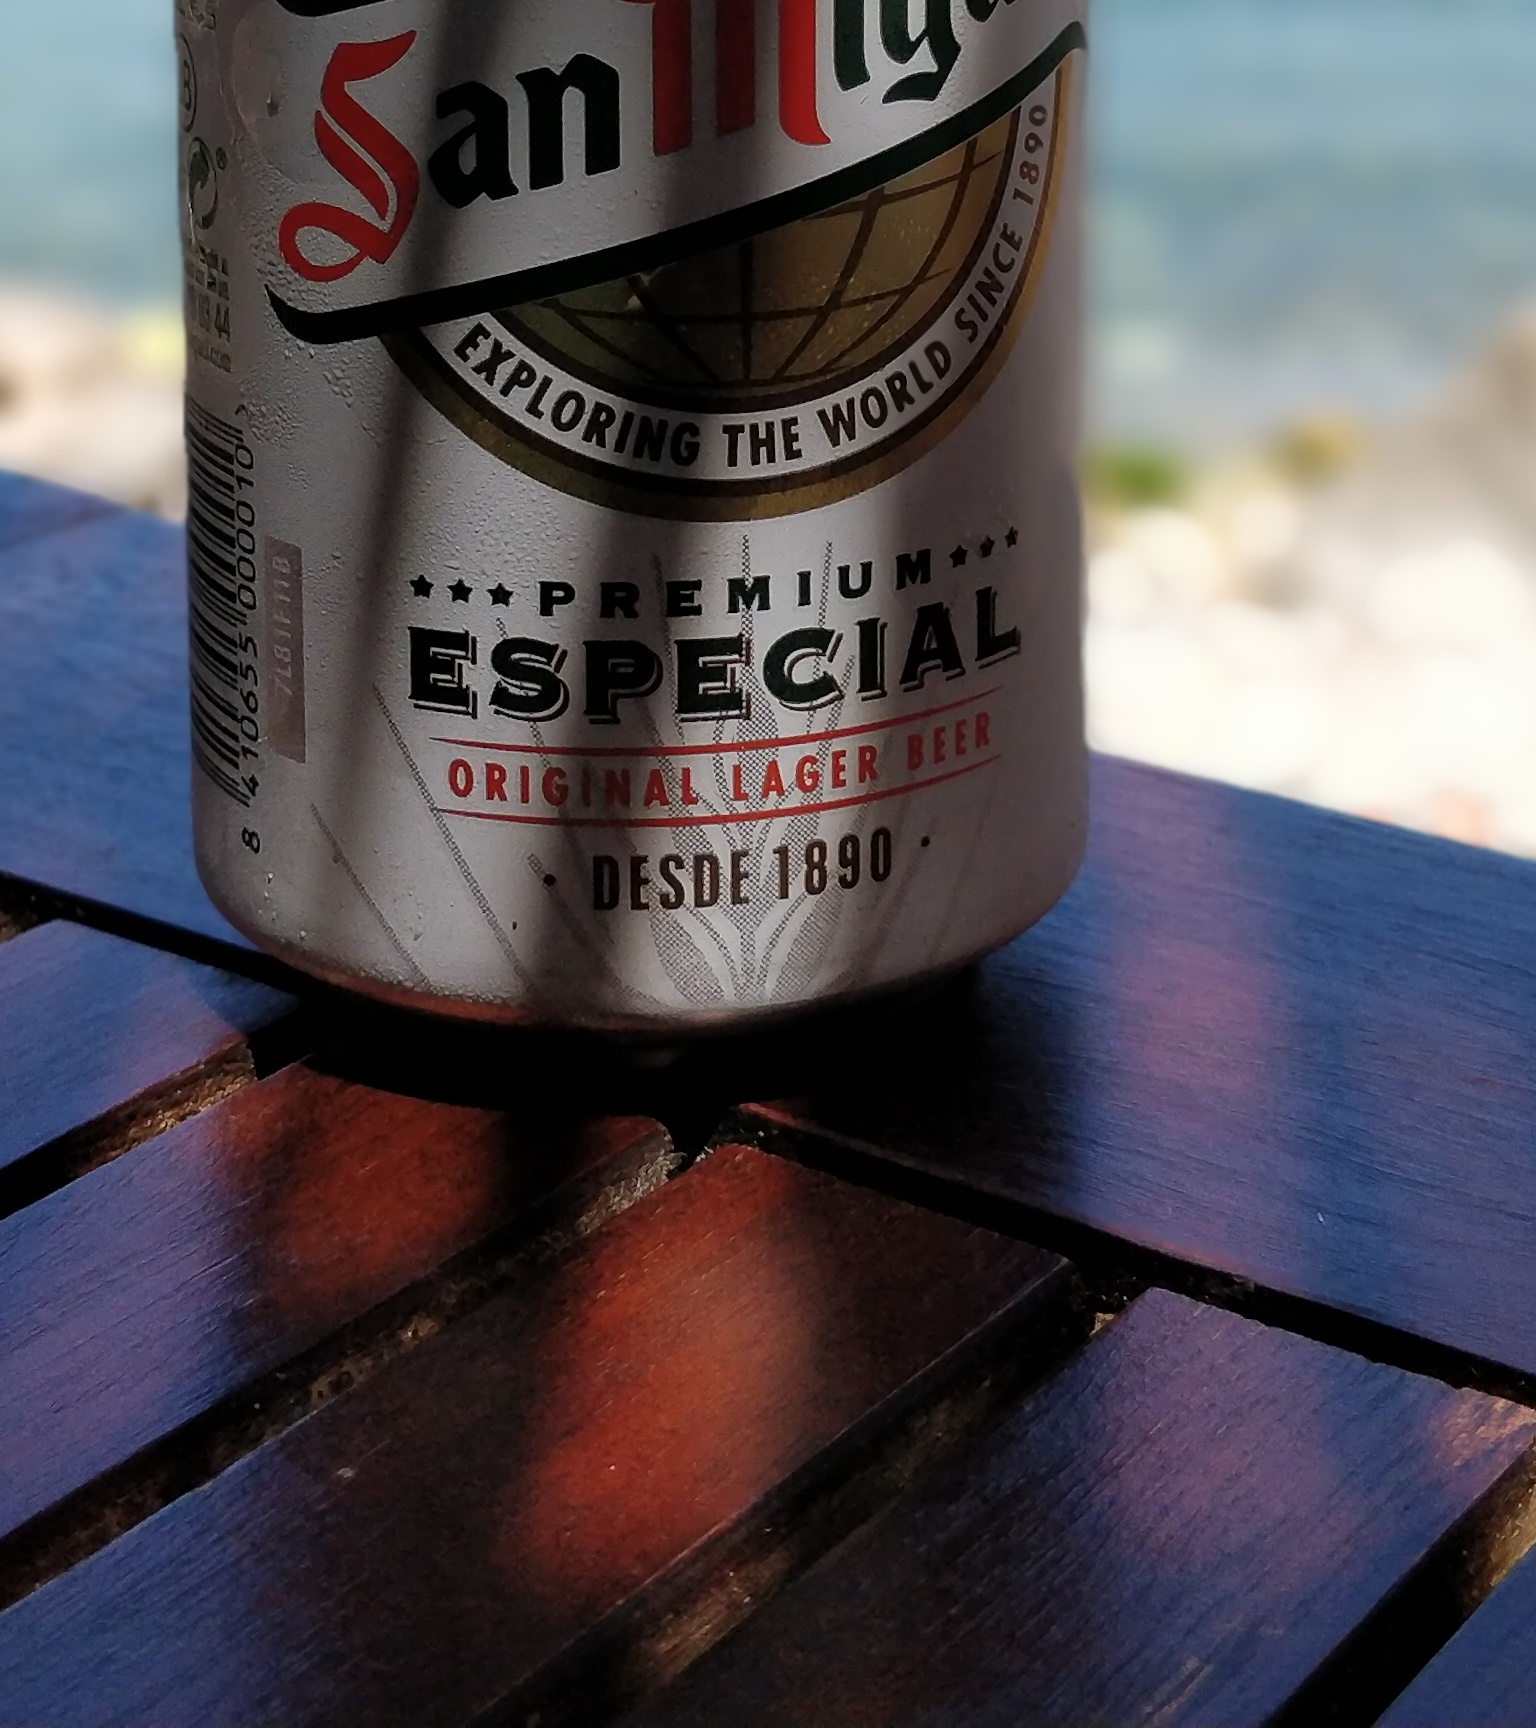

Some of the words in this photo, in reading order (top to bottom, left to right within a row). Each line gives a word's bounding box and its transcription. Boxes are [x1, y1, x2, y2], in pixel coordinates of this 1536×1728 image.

[278, 28, 623, 283] San
[452, 322, 702, 468] EXPLORING
[721, 414, 803, 469] THE
[817, 339, 954, 445] WORLD
[954, 221, 1024, 344] SINCE
[1012, 102, 1050, 208] 1890
[234, 443, 258, 613] 000010
[537, 546, 933, 620] PREMIUM
[237, 633, 261, 798] 410655
[406, 584, 1022, 726] ESPECIAL
[448, 757, 702, 808] ORIGINAL
[730, 744, 880, 804] LAGER
[906, 710, 993, 773] BEER
[241, 826, 261, 856] 8
[591, 846, 752, 913] DESDE
[772, 826, 894, 902] 1890
